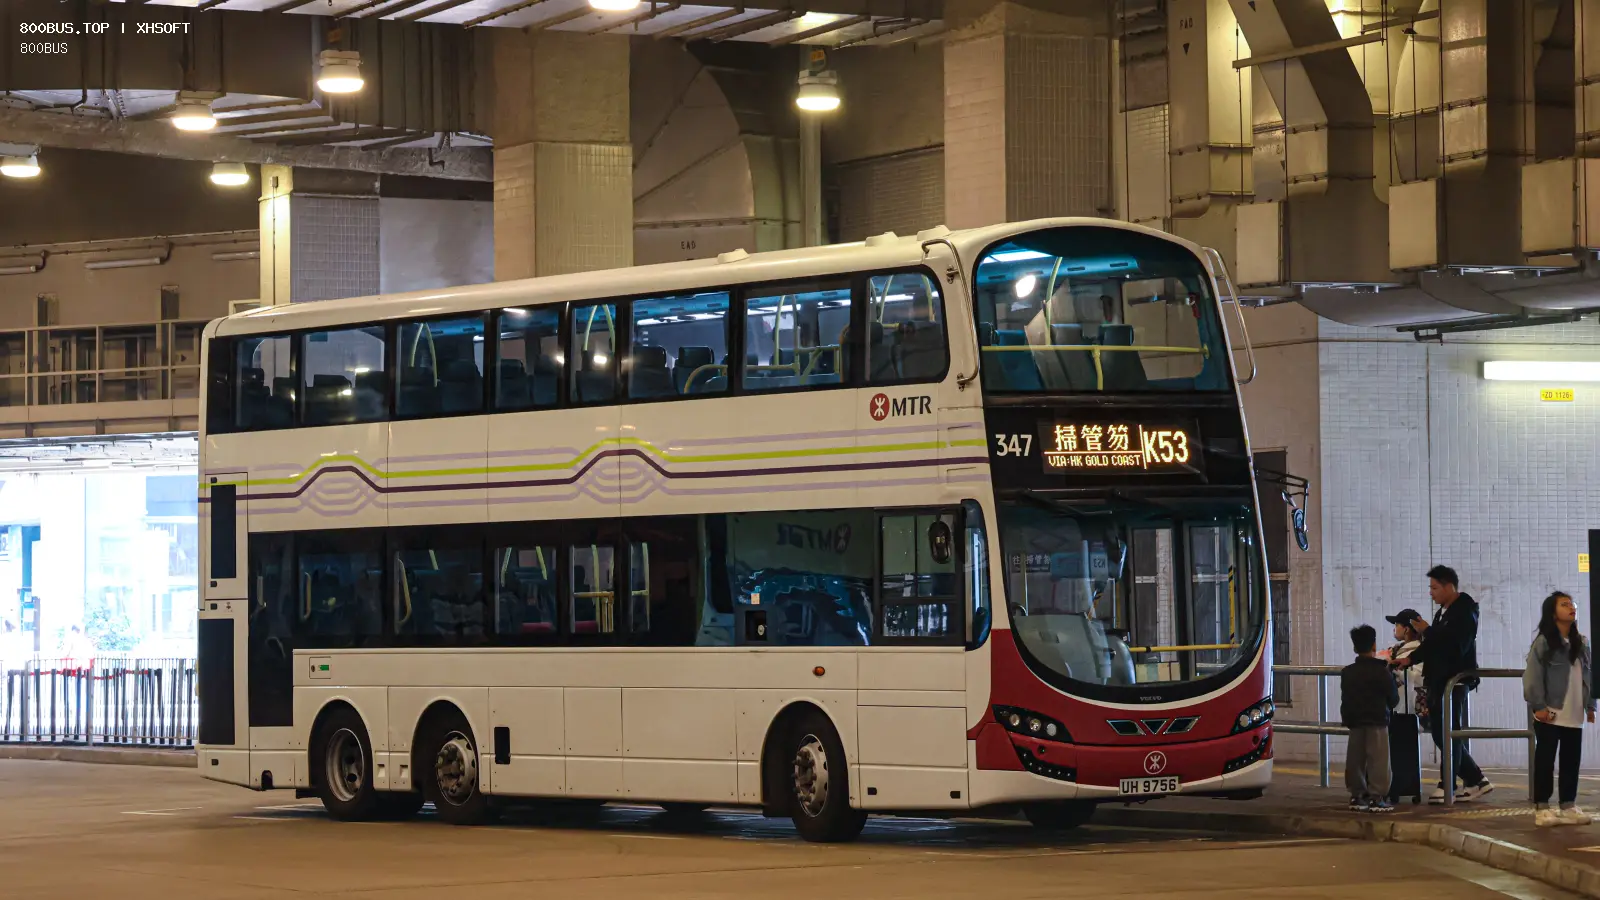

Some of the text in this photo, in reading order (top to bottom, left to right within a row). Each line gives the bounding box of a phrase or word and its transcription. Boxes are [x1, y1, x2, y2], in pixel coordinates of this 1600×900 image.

[892, 395, 932, 417] MTR
[995, 433, 1033, 457] 347
[1054, 424, 1129, 452] 掃管笏
[1143, 430, 1189, 463] K53
[1048, 454, 1141, 467] VIA:HK GOLD COAST
[1121, 779, 1177, 794] UH 9756
